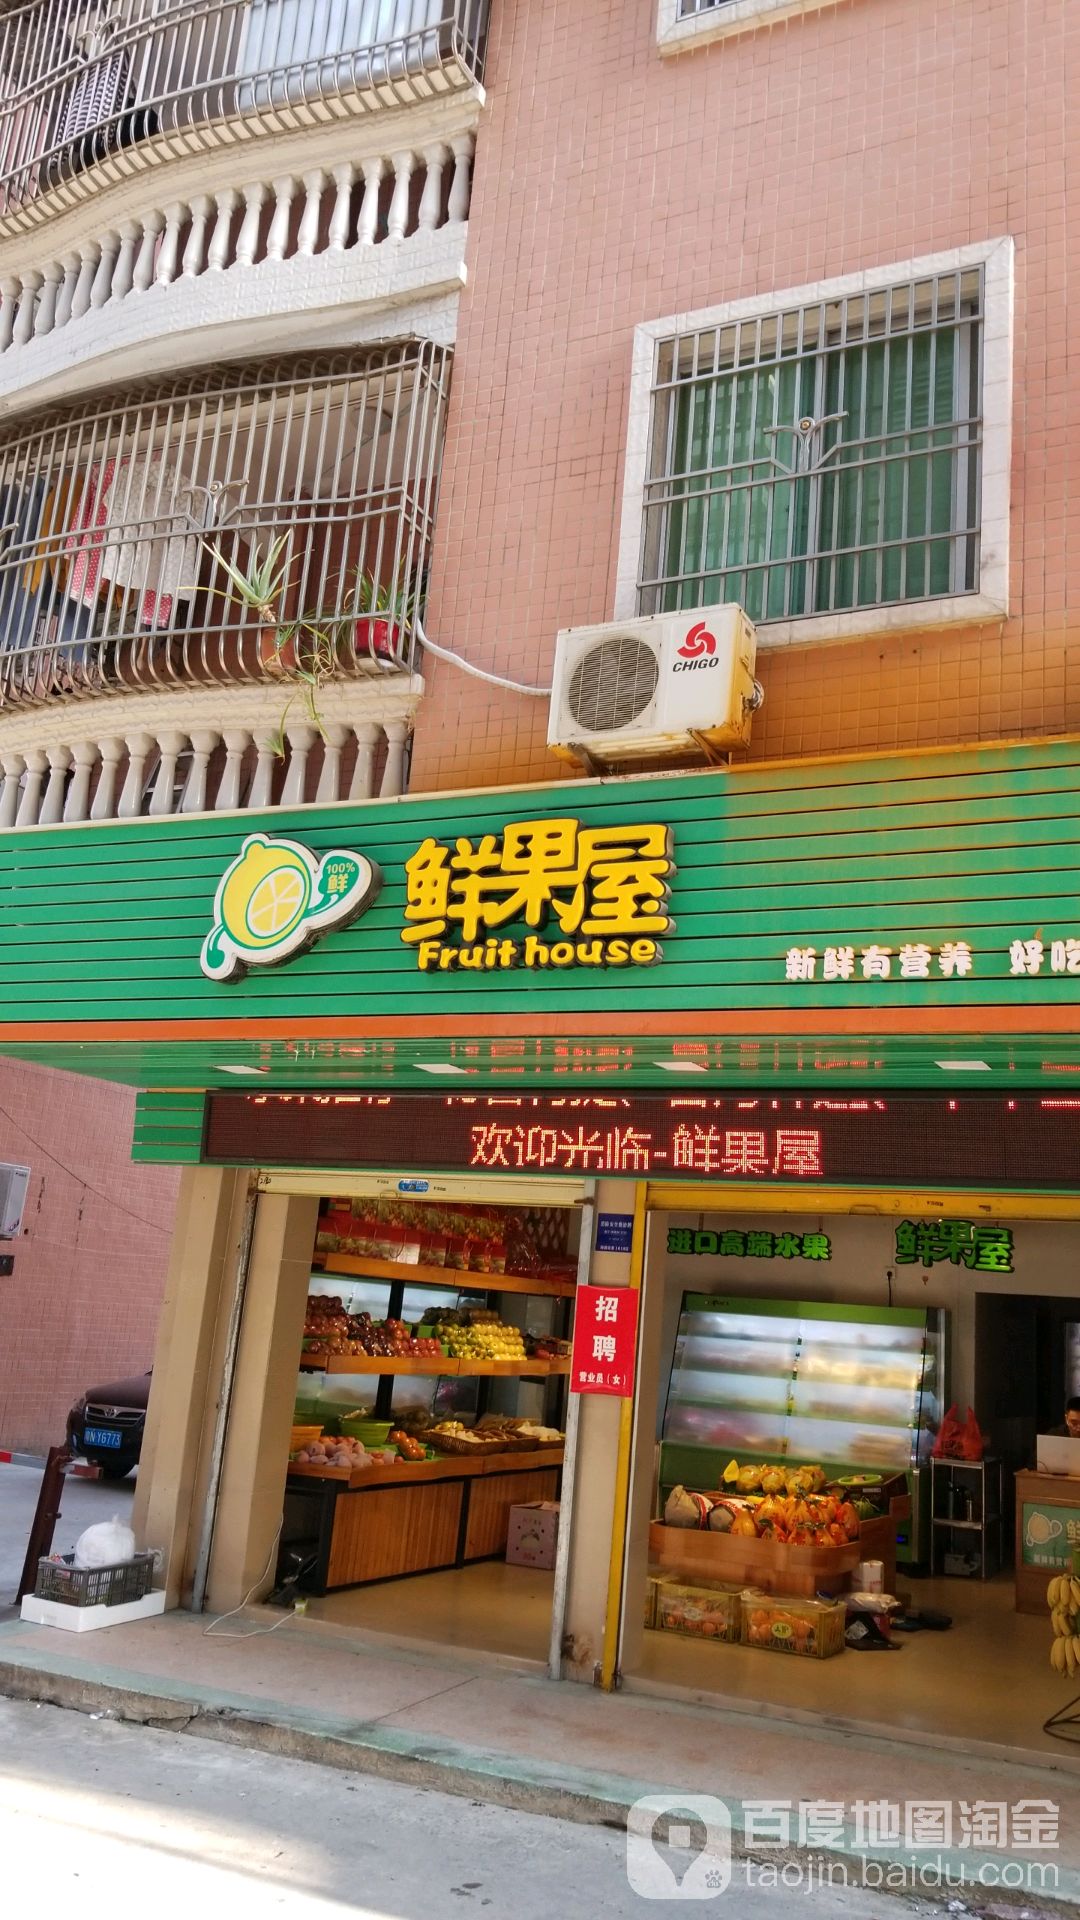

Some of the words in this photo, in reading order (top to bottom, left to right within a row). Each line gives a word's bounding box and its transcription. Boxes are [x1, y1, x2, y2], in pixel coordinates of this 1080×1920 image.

[673, 657, 719, 672] CHIGO
[326, 862, 356, 874] 100%
[327, 873, 349, 893] 鲜
[401, 818, 674, 942] 鲜果屋
[418, 940, 517, 970] Fruit
[525, 936, 657, 967] house
[785, 941, 973, 980] 新鲜有营养
[668, 1228, 831, 1260] 进口高端水果
[895, 1219, 1014, 1272] 鲜果屋
[592, 1295, 618, 1362] 招聘
